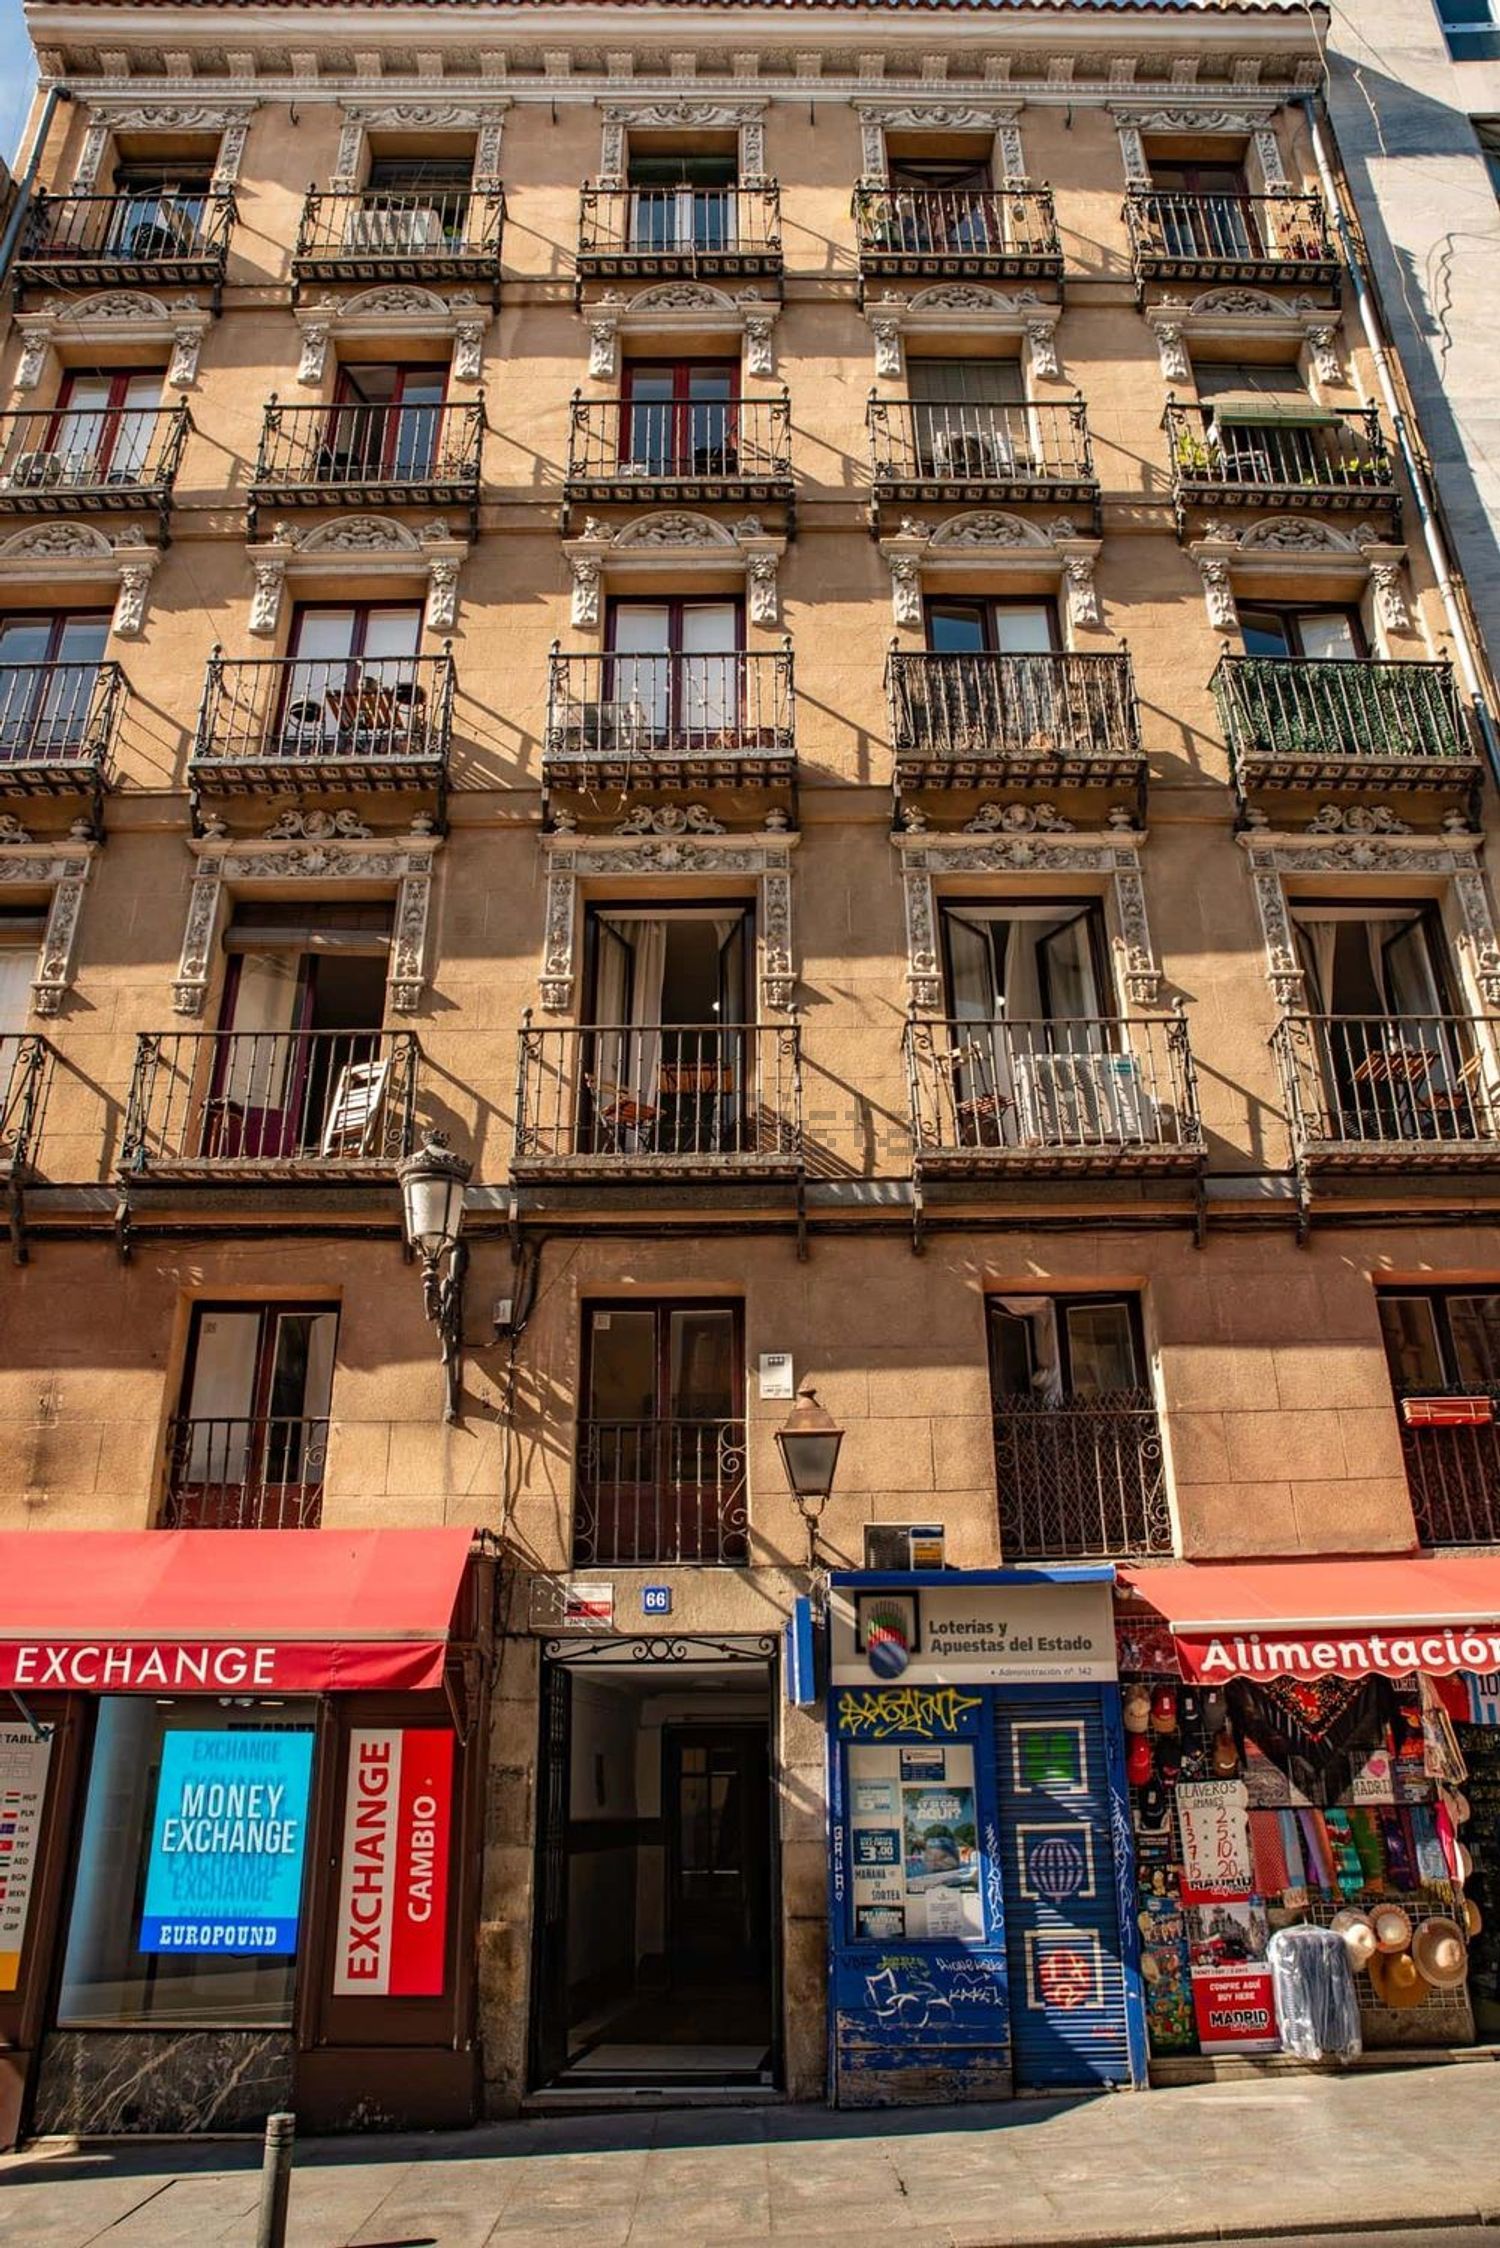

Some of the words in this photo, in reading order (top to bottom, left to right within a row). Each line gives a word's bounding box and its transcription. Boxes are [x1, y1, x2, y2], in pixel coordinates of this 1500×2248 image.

[646, 1592, 666, 1607] 66
[929, 1619, 994, 1634] Loterías
[998, 1622, 1008, 1637] y
[931, 1639, 1005, 1656] Apuestas
[1009, 1637, 1033, 1650] del
[1038, 1636, 1092, 1650] Estado
[14, 1646, 276, 1685] EXCHANGE
[192, 1739, 281, 1764] EXCHANGE
[1178, 1781, 1237, 1799] LLAVEROS
[181, 1784, 284, 1819] MONEY
[1216, 1807, 1229, 1824] 2
[162, 1819, 298, 1854] EXCHANGE
[407, 1795, 437, 1922] CAMBIO
[1217, 1841, 1233, 1858] 10
[347, 1742, 391, 1980] EXCHANGE
[1218, 1860, 1238, 1878] 20
[159, 1926, 277, 1946] EUROPOUND
[1209, 1982, 1240, 1991] COMPRE
[1217, 1993, 1232, 2001] BUY
[1235, 1991, 1256, 2001] HERE
[1210, 2009, 1268, 2026] MADRID
